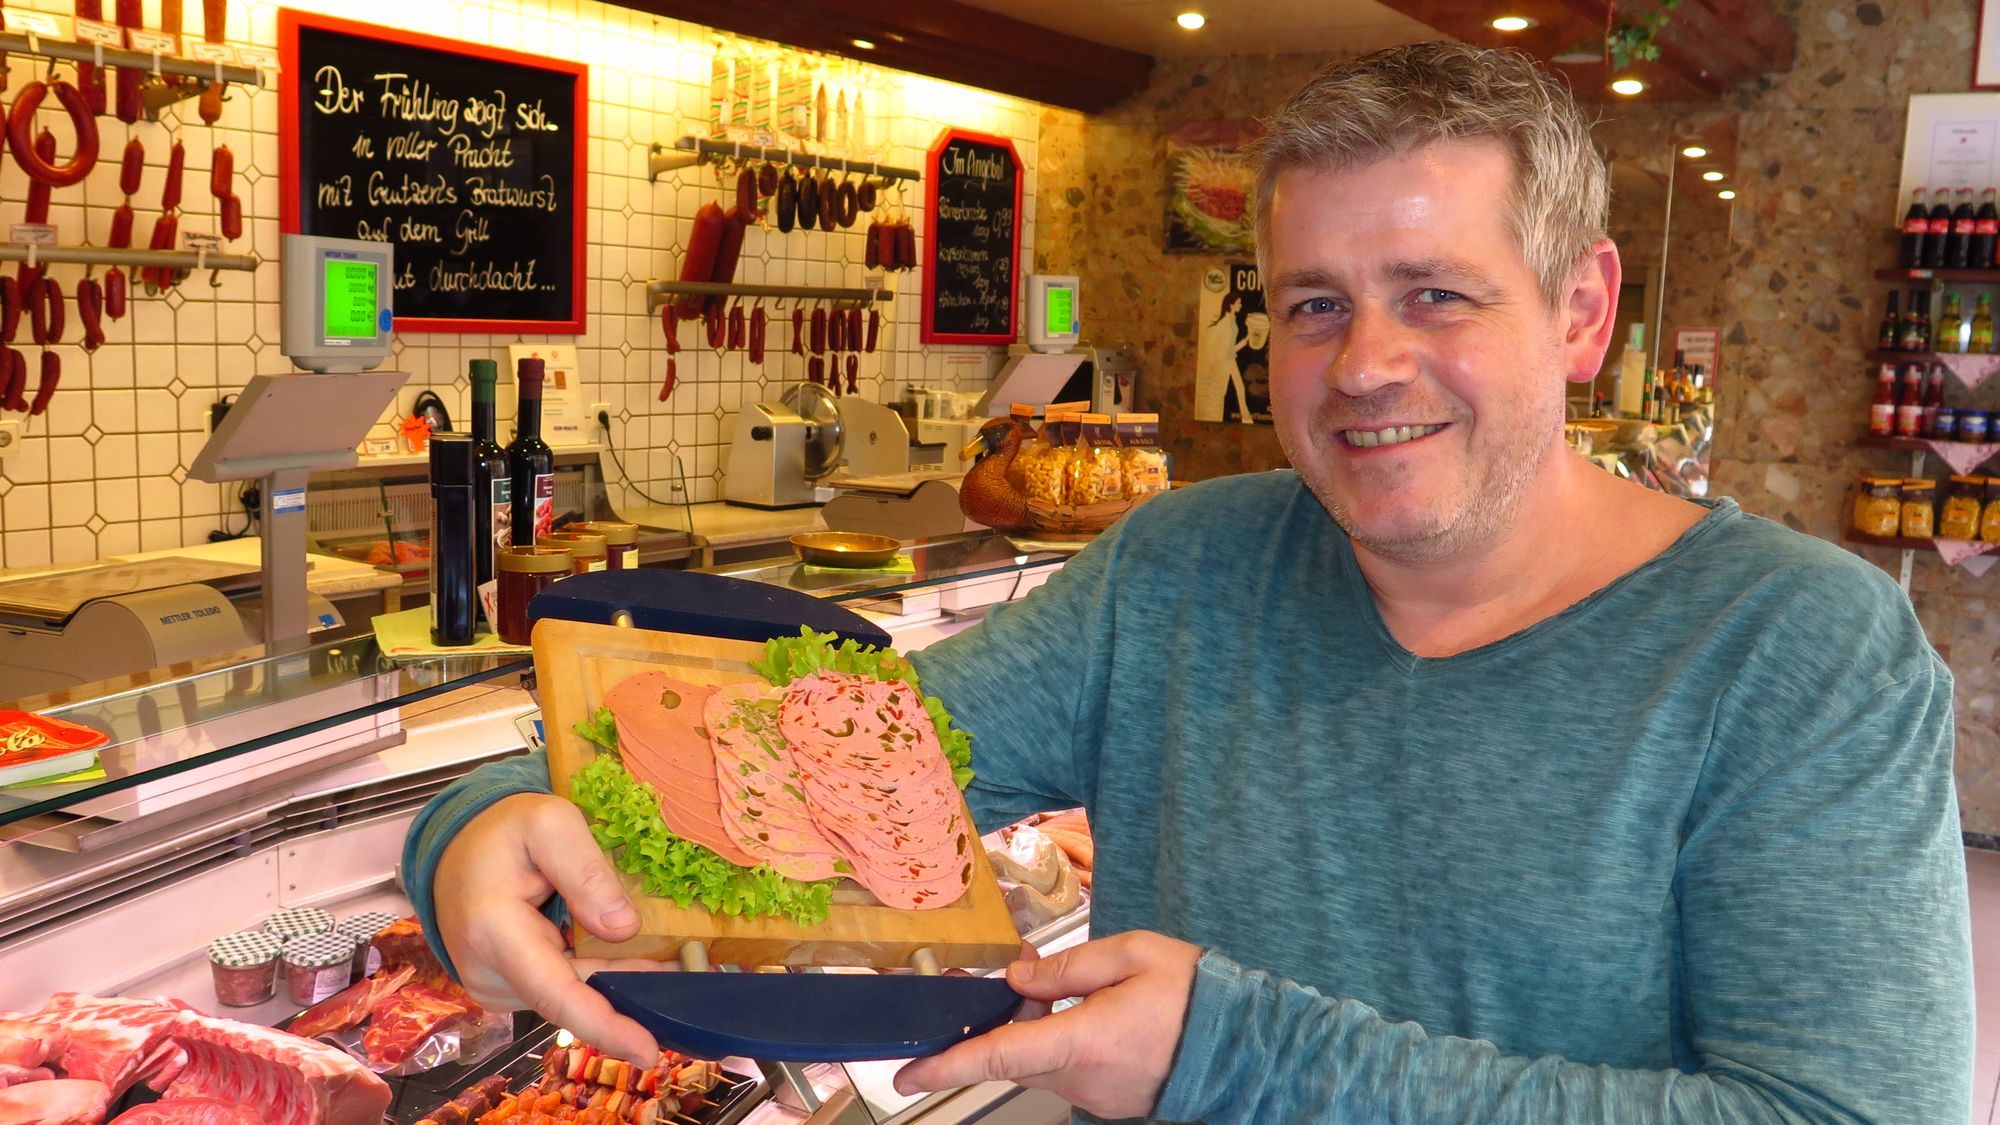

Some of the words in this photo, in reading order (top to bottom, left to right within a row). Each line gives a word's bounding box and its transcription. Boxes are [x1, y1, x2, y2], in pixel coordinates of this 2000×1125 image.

[314, 65, 364, 114] Der
[373, 72, 458, 135] Frühling
[352, 130, 374, 158] in
[387, 131, 438, 161] voller
[447, 133, 514, 168] Pracht
[318, 175, 353, 209] mit
[465, 174, 557, 212] Bratwurst
[357, 216, 392, 242] auf
[400, 215, 443, 242] dem
[450, 208, 490, 255] Grill
[393, 262, 416, 290] ut
[159, 611, 193, 625] METTLER
[191, 605, 221, 618] TOLEDO
